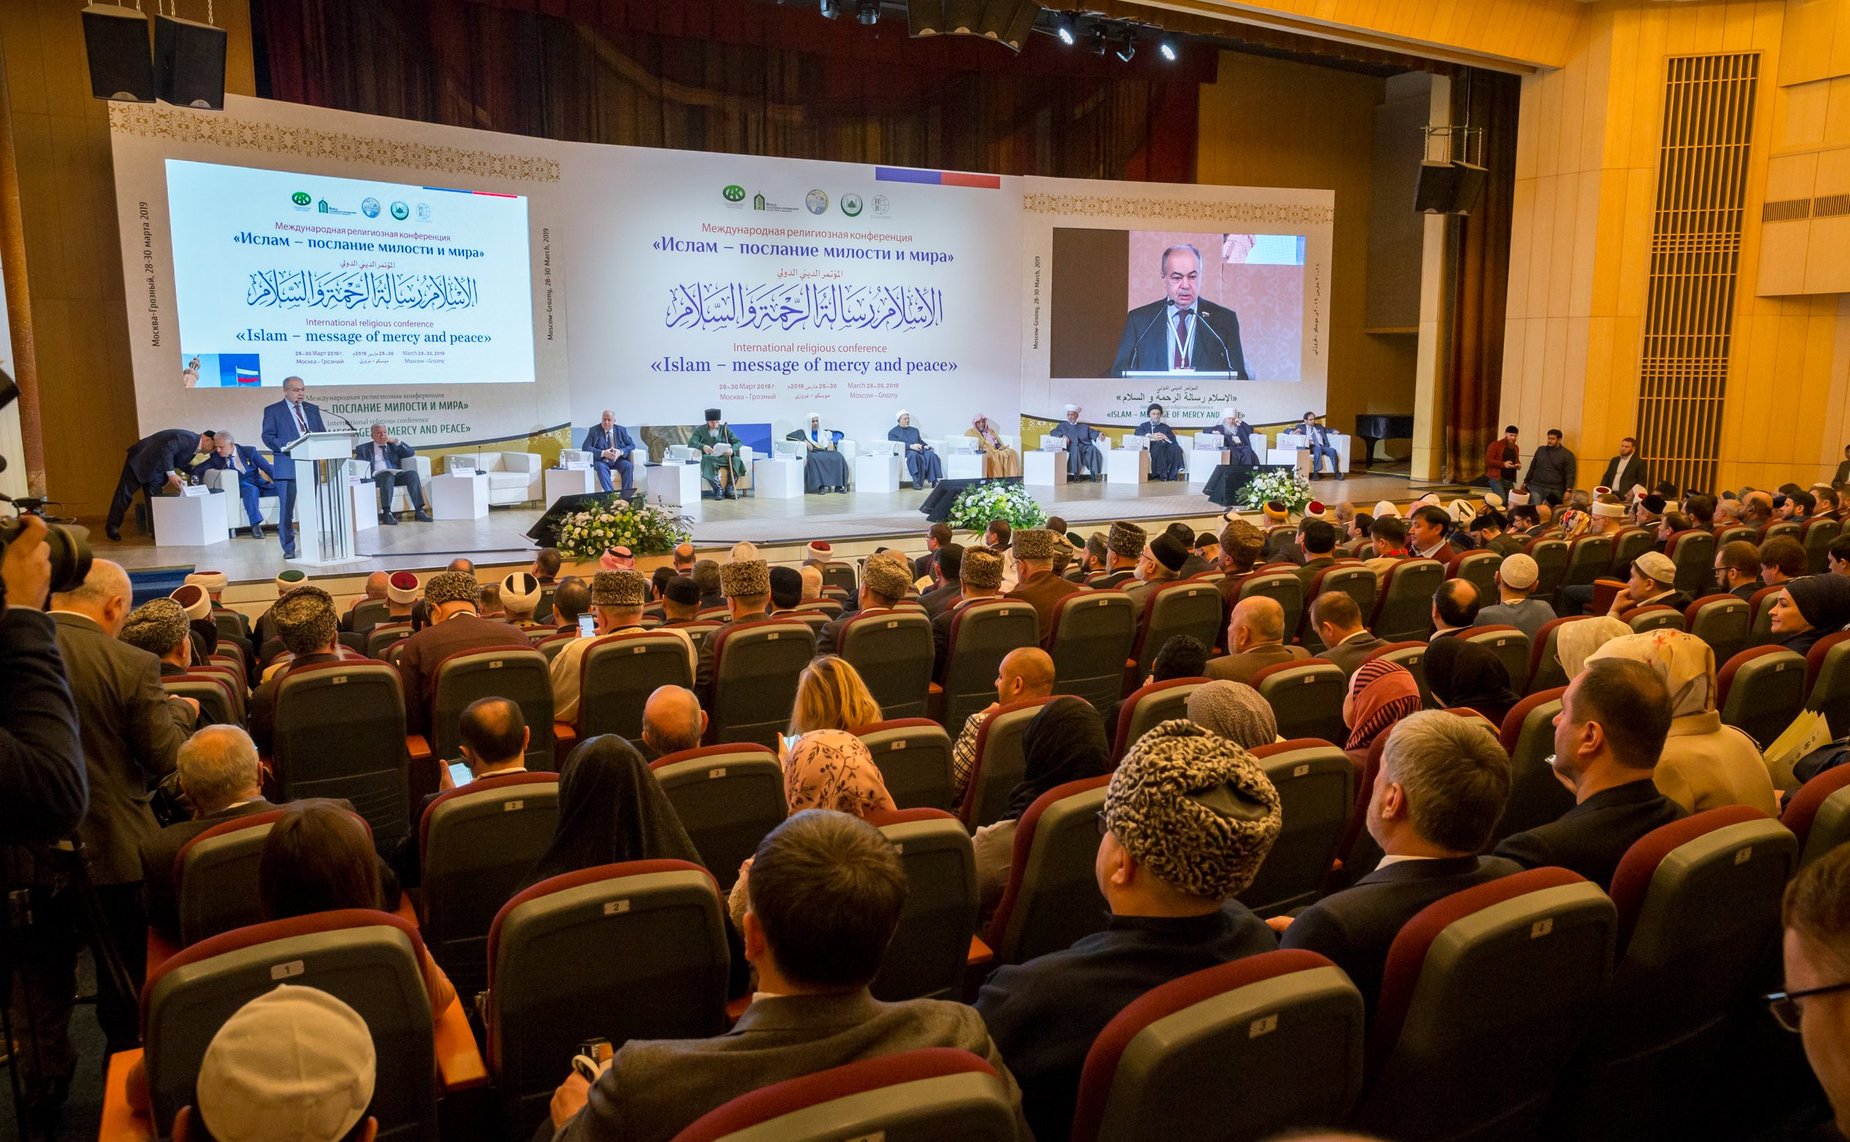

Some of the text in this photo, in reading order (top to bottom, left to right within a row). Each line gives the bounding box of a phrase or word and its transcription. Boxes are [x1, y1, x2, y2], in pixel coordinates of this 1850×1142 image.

[275, 221, 451, 242] Международная религиозная конференция
[702, 222, 913, 243] Международная религиозная конференция
[233, 231, 290, 247] «Ислам
[307, 238, 375, 252] послание
[378, 243, 434, 256] милости
[437, 247, 445, 256] и
[448, 248, 485, 260] мира»
[653, 236, 718, 254] «Ислам
[740, 243, 819, 256] послание
[823, 247, 891, 260] милости
[896, 250, 905, 261] и
[910, 251, 954, 266] мира»
[138, 201, 160, 347] Москва-Грозный, 28-30 марта 2019
[305, 318, 434, 329] International religious conference
[236, 328, 288, 342] «Islam
[305, 331, 363, 345] message
[366, 330, 381, 343] of
[382, 332, 421, 345] mercy
[424, 331, 447, 343] and
[449, 333, 492, 346] peace»
[733, 342, 888, 355] International religious conference
[651, 356, 711, 372] «Islam
[732, 360, 800, 375] message
[803, 357, 821, 372] of
[823, 360, 870, 375] mercy
[874, 357, 902, 372] and
[906, 361, 958, 375] peace»
[749, 393, 777, 401] Грозный
[332, 403, 382, 414] ПОСЛАНИЕ
[384, 402, 428, 413] МИЛОСТИ
[430, 401, 437, 412] И
[439, 400, 469, 411] МИРА»
[1107, 410, 1132, 418] «ISLAM
[387, 423, 471, 437] MERCY AND PEACE»
[1259, 1020, 1266, 1032] 3
